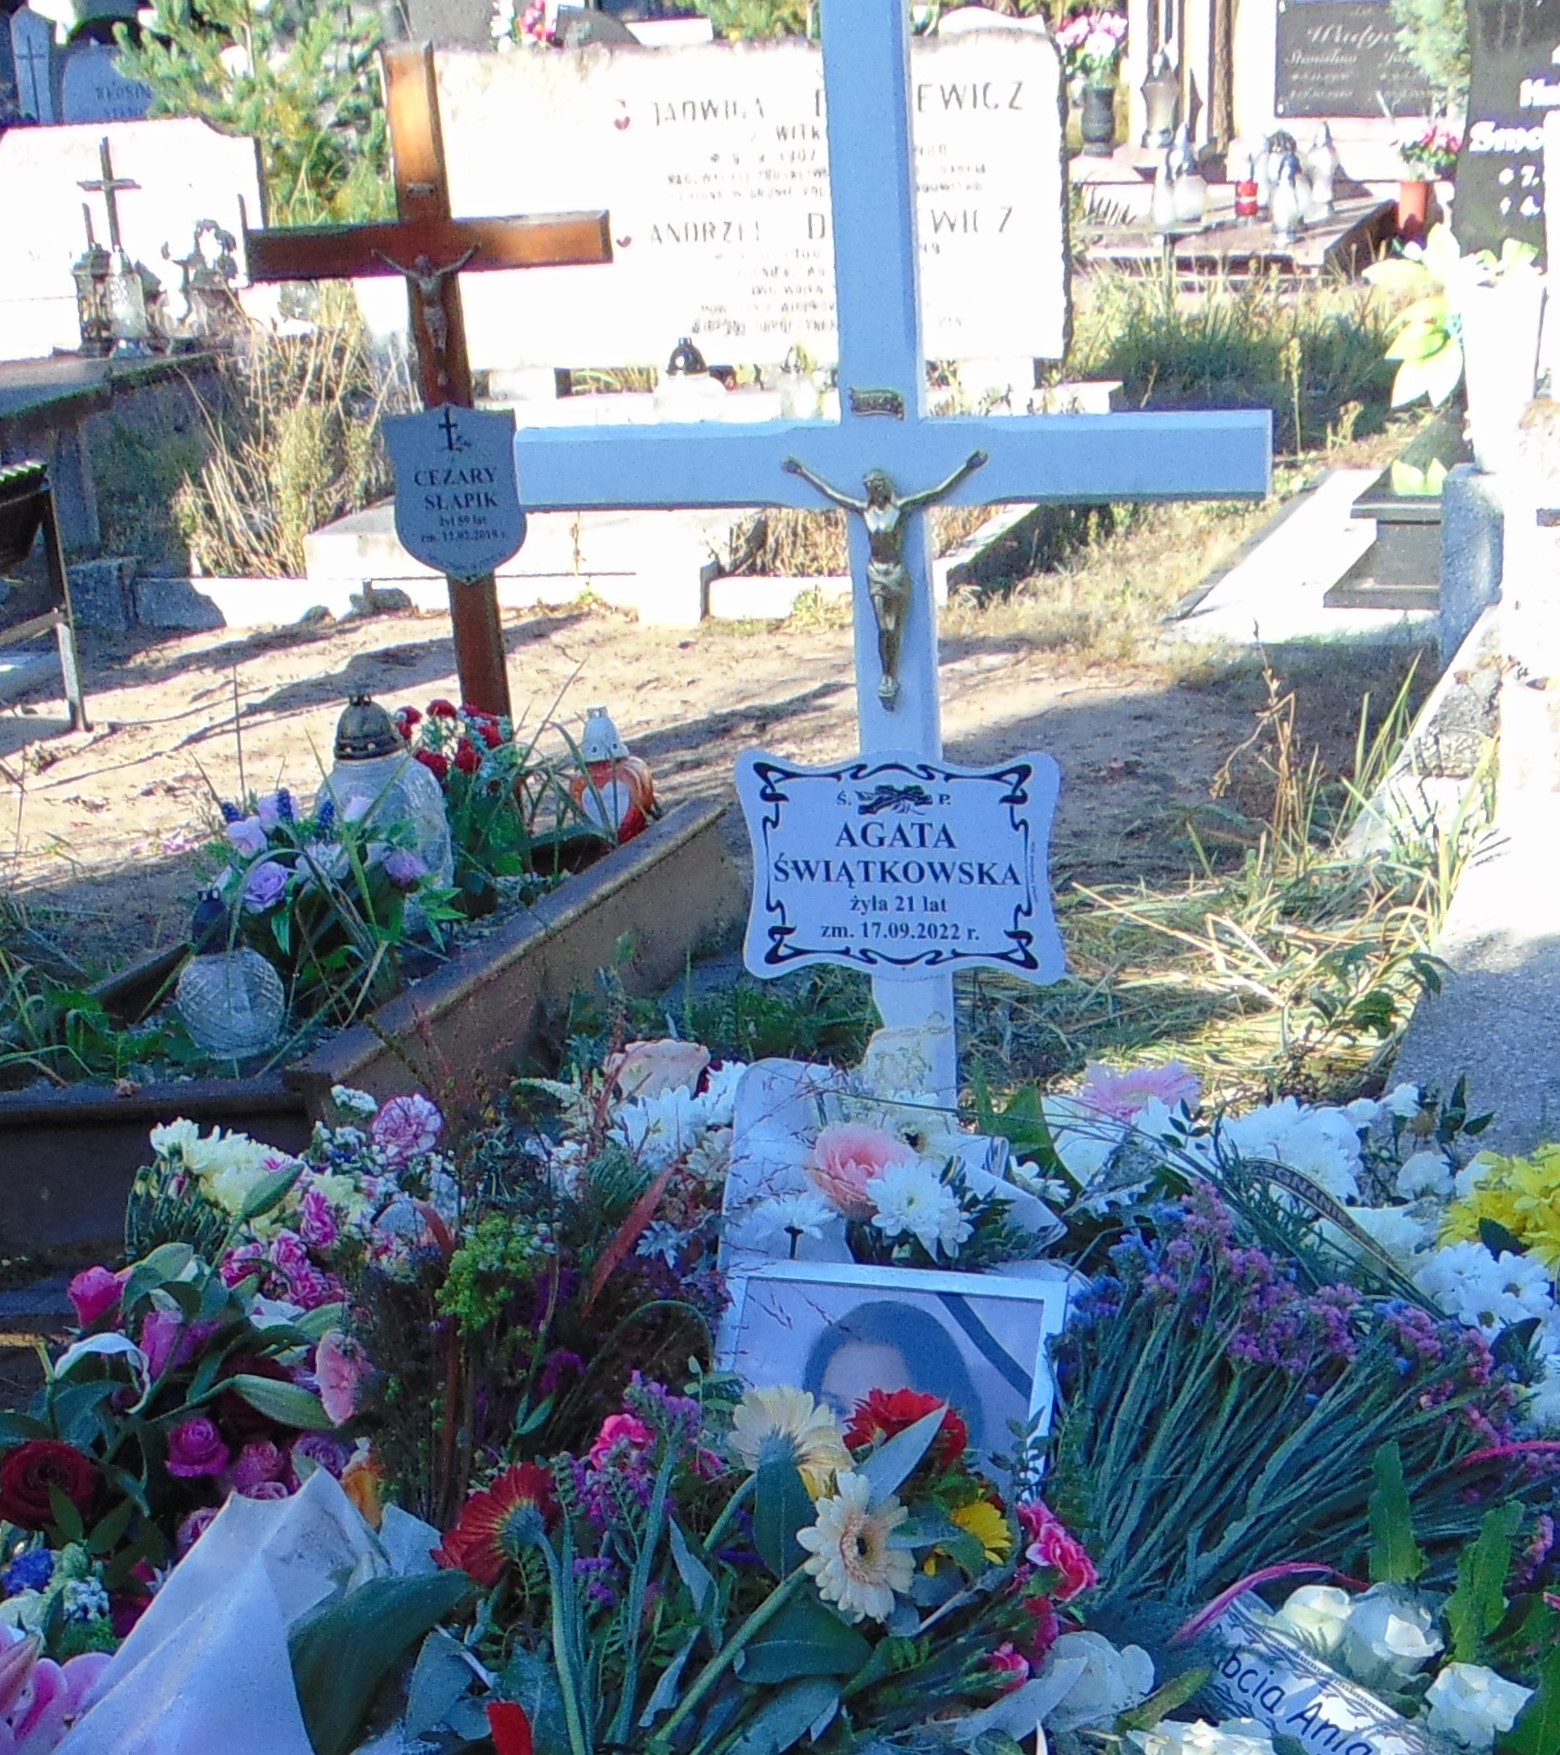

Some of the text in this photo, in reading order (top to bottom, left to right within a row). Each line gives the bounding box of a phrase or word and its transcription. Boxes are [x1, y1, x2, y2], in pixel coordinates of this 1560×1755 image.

[413, 466, 497, 487] CEZARY
[835, 821, 959, 850] AGATA
[773, 852, 1023, 889] ŚWIĄTKOWSKA
[849, 895, 949, 915] żyła 21 lat
[820, 921, 980, 941] zm. 17.09.2022 r.
